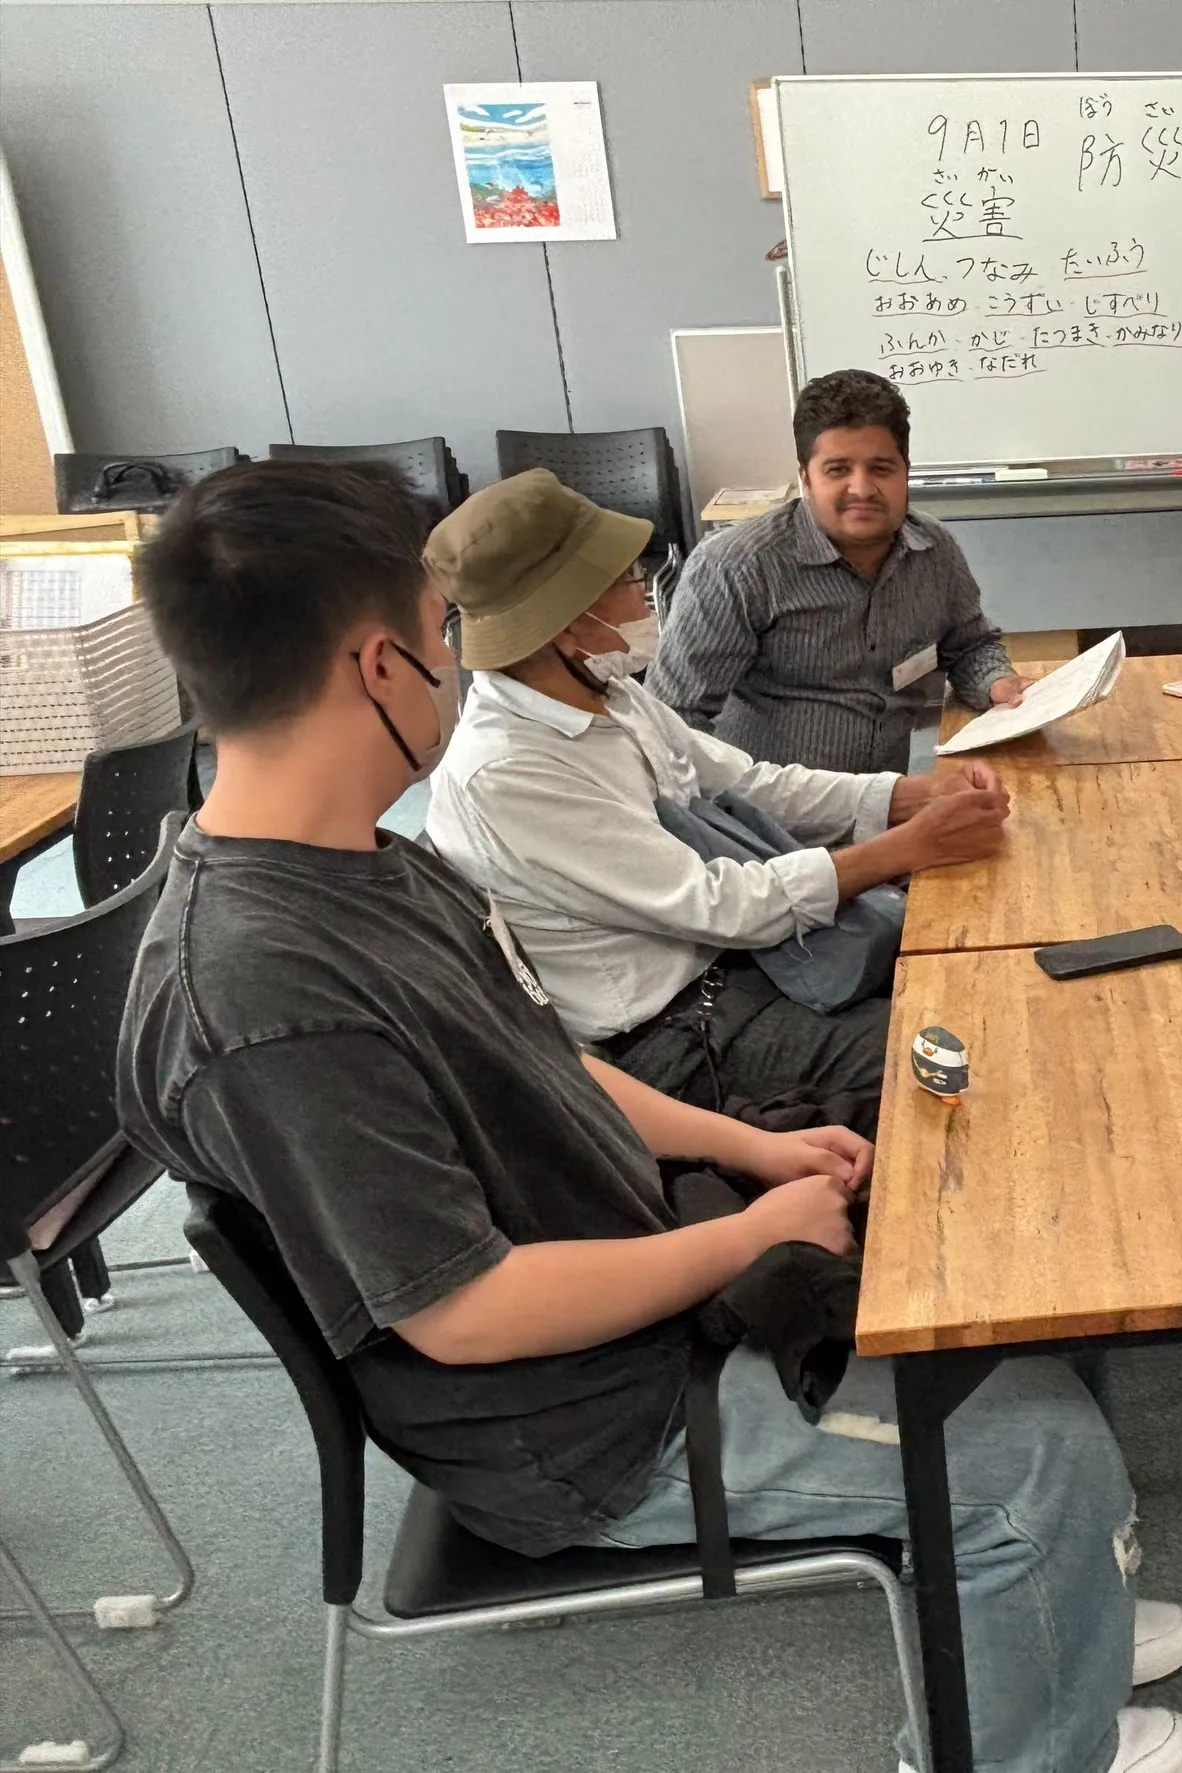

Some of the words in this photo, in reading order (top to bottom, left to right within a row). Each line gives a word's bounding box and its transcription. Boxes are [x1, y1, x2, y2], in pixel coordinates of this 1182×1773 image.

[1079, 92, 1113, 120] ぼう
[1145, 101, 1176, 119] さい
[927, 114, 1041, 162] 9月1日
[920, 185, 1016, 239] 災害
